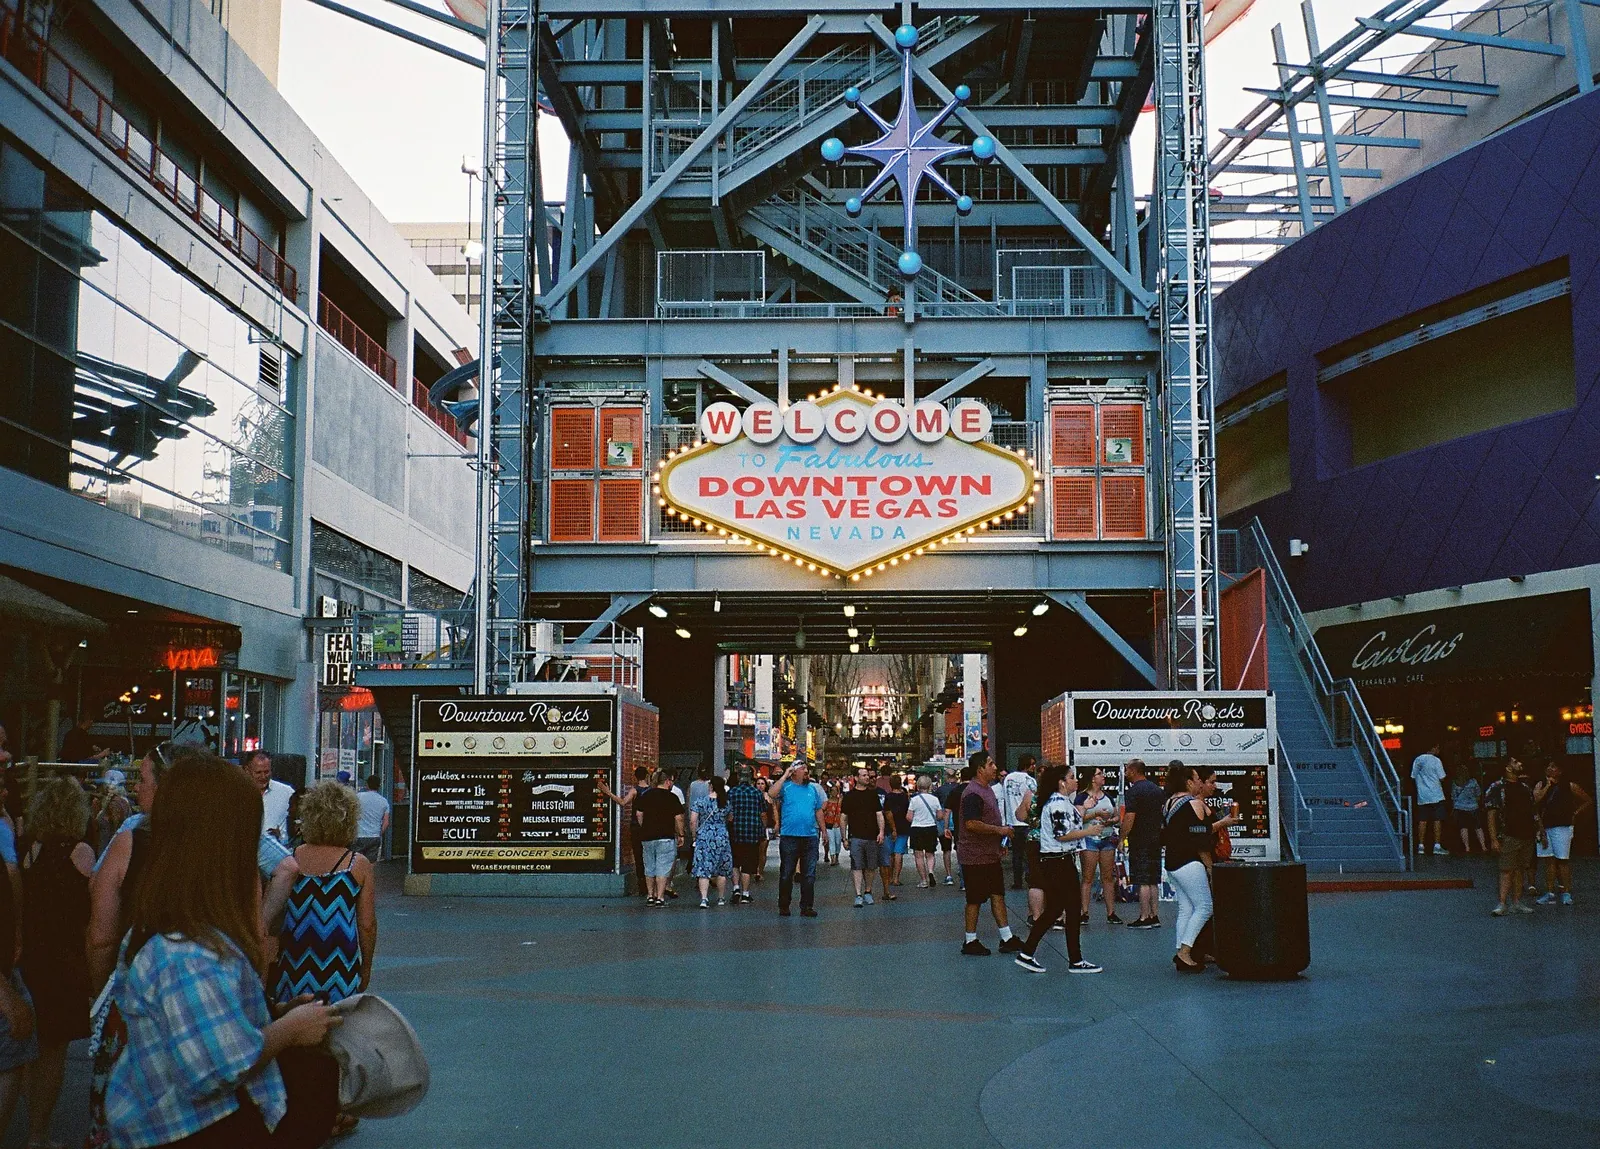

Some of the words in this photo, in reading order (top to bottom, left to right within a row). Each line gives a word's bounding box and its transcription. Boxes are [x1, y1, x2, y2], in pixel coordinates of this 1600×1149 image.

[705, 409, 983, 435] WELCOME
[616, 446, 625, 457] 2
[1114, 442, 1124, 453] 2
[738, 453, 766, 468] TO
[774, 444, 933, 474] Fabulous
[699, 475, 992, 497] DOWNTOWN
[734, 500, 807, 519] LAS
[819, 499, 959, 519] VEGAS
[787, 525, 906, 540] NEVADA
[327, 634, 363, 651] FEAR
[167, 648, 216, 670] VIVA
[327, 652, 373, 661] WALNG
[1406, 674, 1425, 683] CAFE
[438, 702, 526, 722] Downtown
[529, 702, 589, 725] Rocks
[1093, 700, 1180, 720] Downtown
[1183, 699, 1245, 722] Rocks
[1480, 726, 1494, 736] BEER
[1570, 723, 1592, 734] GYROS
[448, 829, 478, 839] CULT
